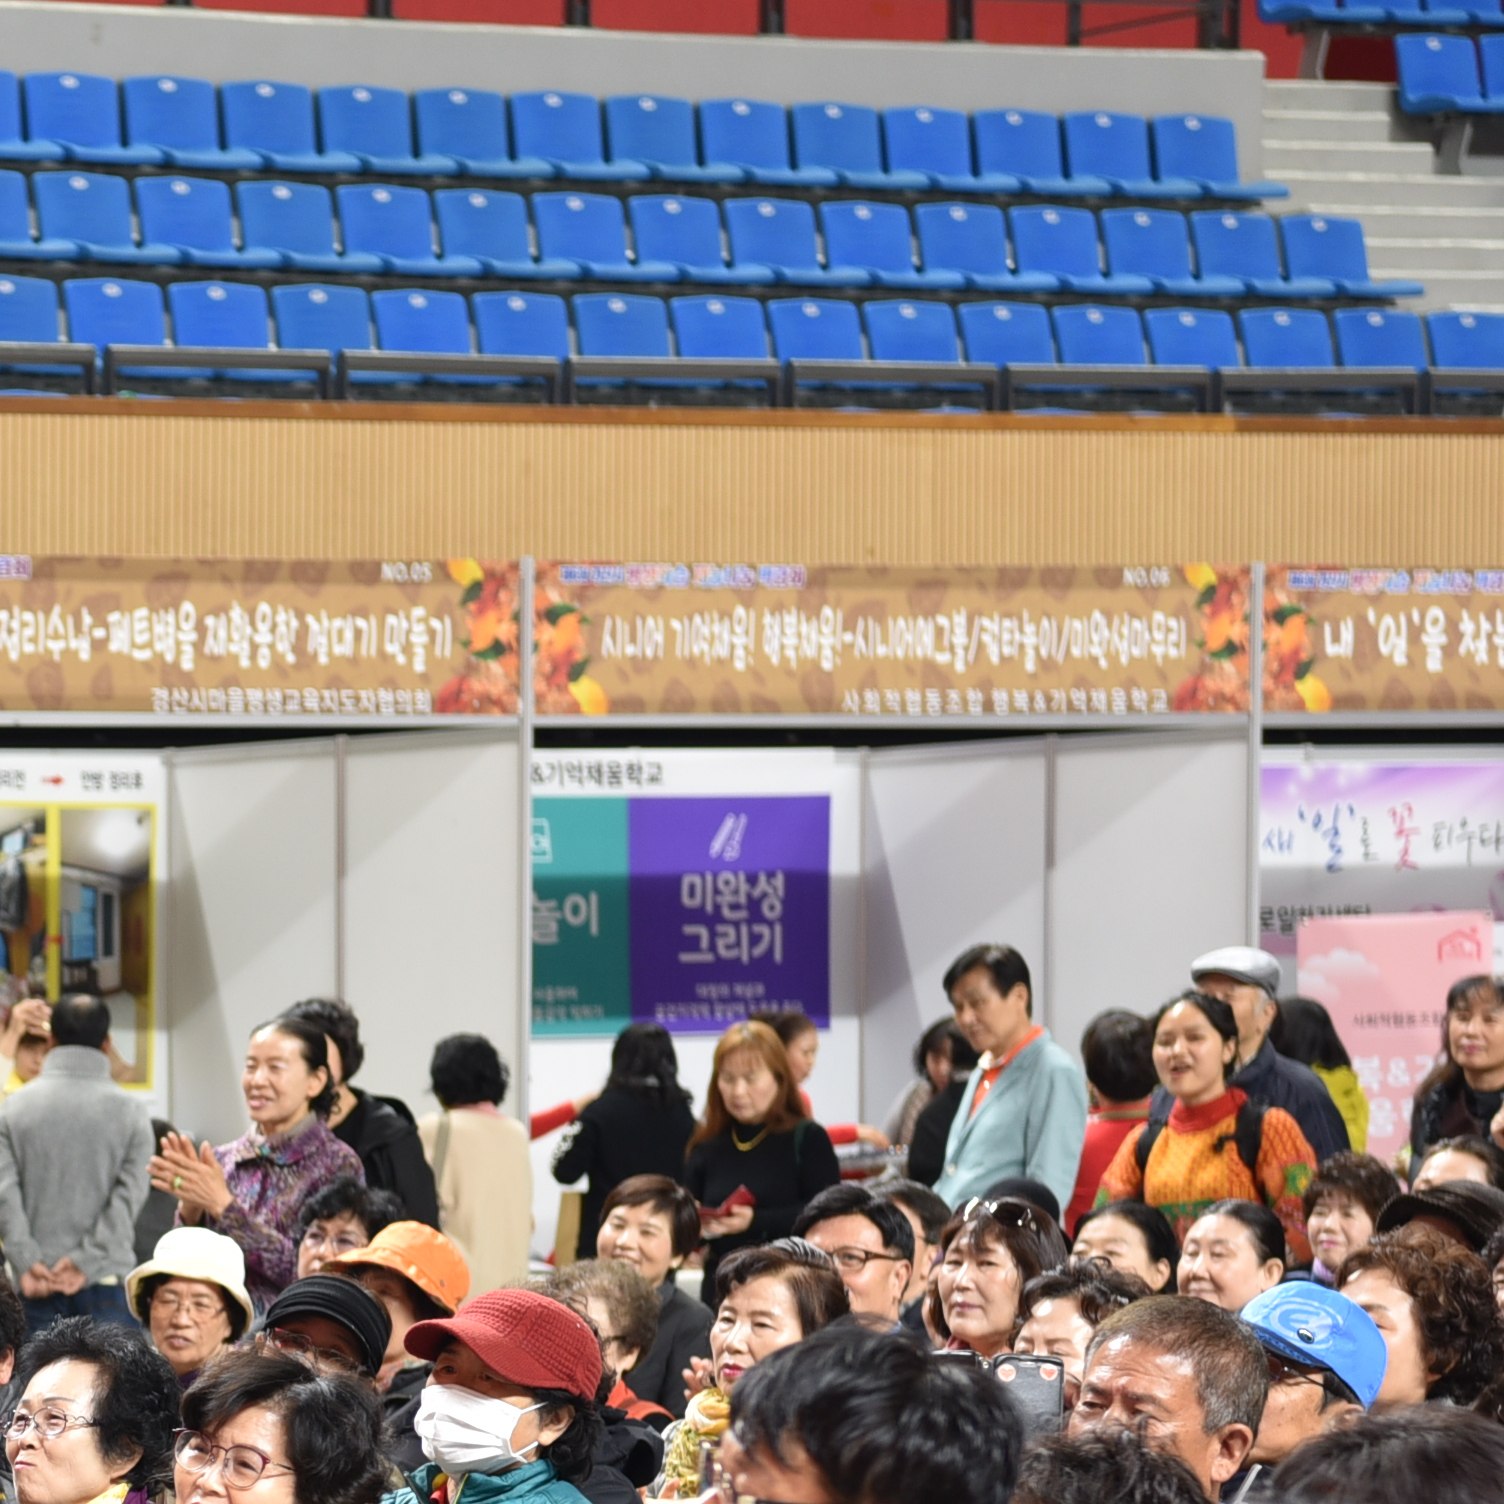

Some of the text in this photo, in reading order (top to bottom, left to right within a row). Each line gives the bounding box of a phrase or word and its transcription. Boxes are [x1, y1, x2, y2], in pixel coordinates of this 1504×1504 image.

[381, 561, 432, 583] NO.05
[203, 599, 299, 670] 재활용한
[383, 604, 453, 674] 만들기
[601, 613, 665, 660] 시니어
[1323, 615, 1355, 659] 내
[679, 869, 786, 922] 미완성
[677, 921, 784, 967] 그리기
